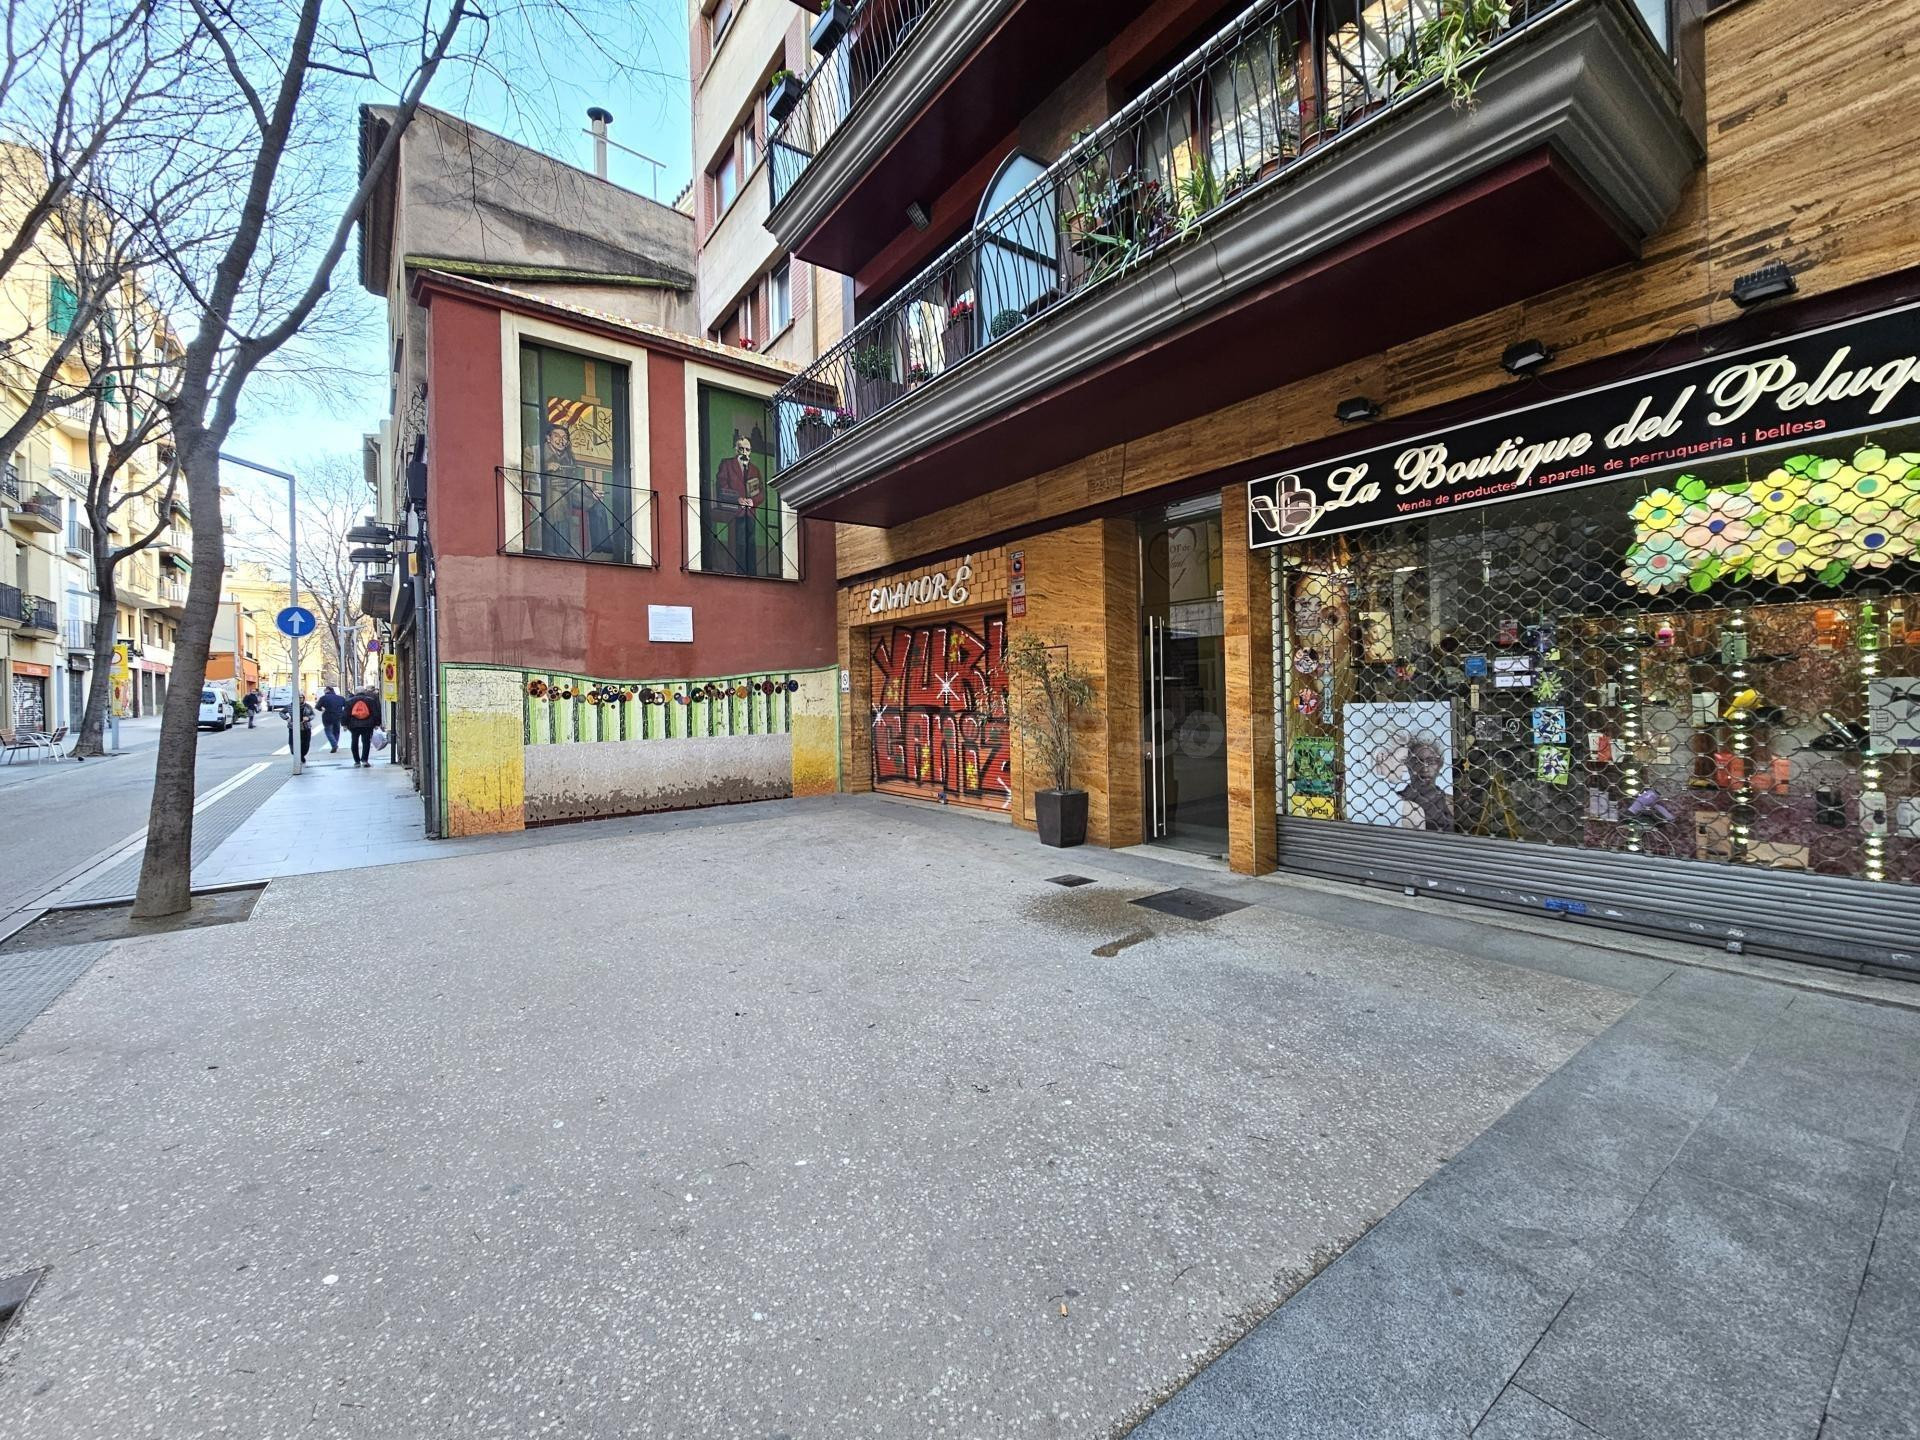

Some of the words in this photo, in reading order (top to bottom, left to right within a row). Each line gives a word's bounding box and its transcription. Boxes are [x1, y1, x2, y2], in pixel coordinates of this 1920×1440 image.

[1324, 462, 1381, 511] La
[1394, 432, 1593, 495] Boutique
[1603, 385, 1697, 449] del
[1396, 498, 1432, 513] Venda
[1435, 494, 1450, 505] de
[1454, 480, 1518, 503] productes
[1528, 476, 1533, 487] i
[1539, 464, 1596, 485] aparells
[1603, 458, 1624, 471] de
[1630, 436, 1733, 468] perruqueria
[1741, 432, 1747, 445] i
[1755, 418, 1827, 442] bellesa
